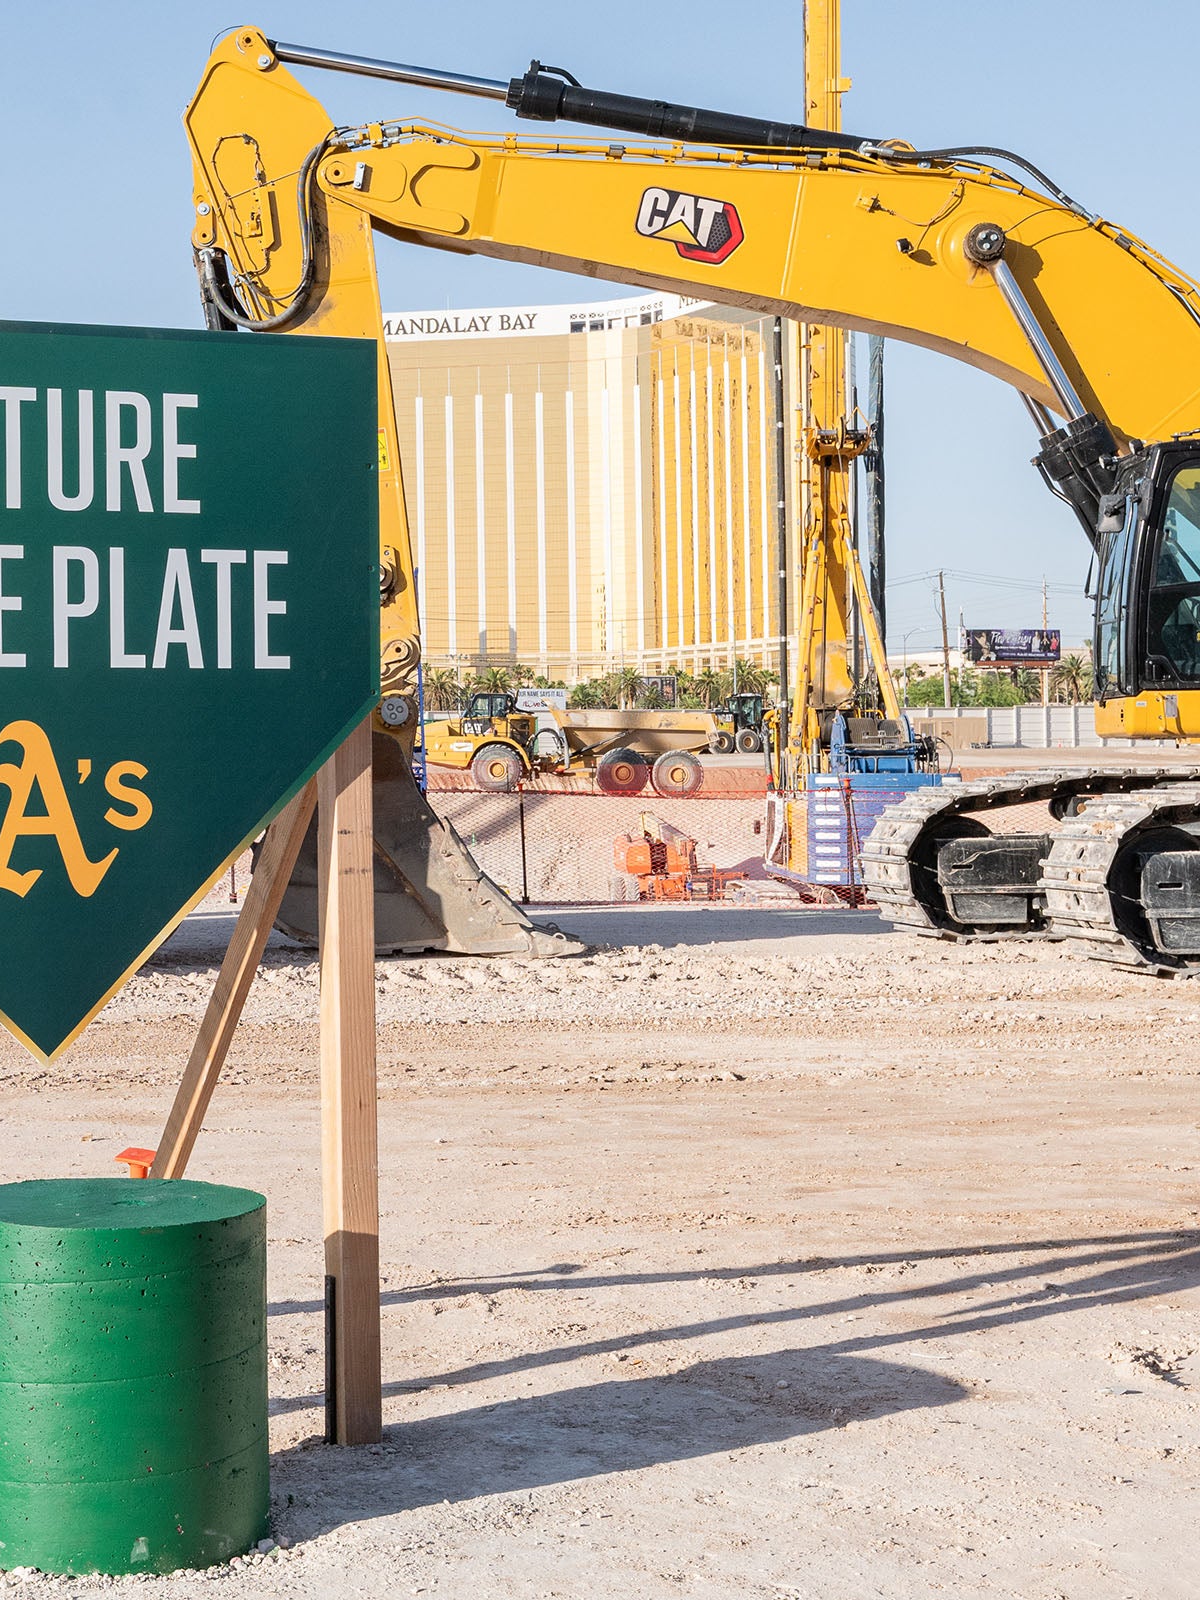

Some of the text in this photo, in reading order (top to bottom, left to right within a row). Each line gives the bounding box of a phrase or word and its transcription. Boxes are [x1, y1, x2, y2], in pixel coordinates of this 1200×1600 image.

[637, 187, 724, 248] CAT
[499, 312, 538, 331] BAY
[52, 545, 291, 670] PLATE
